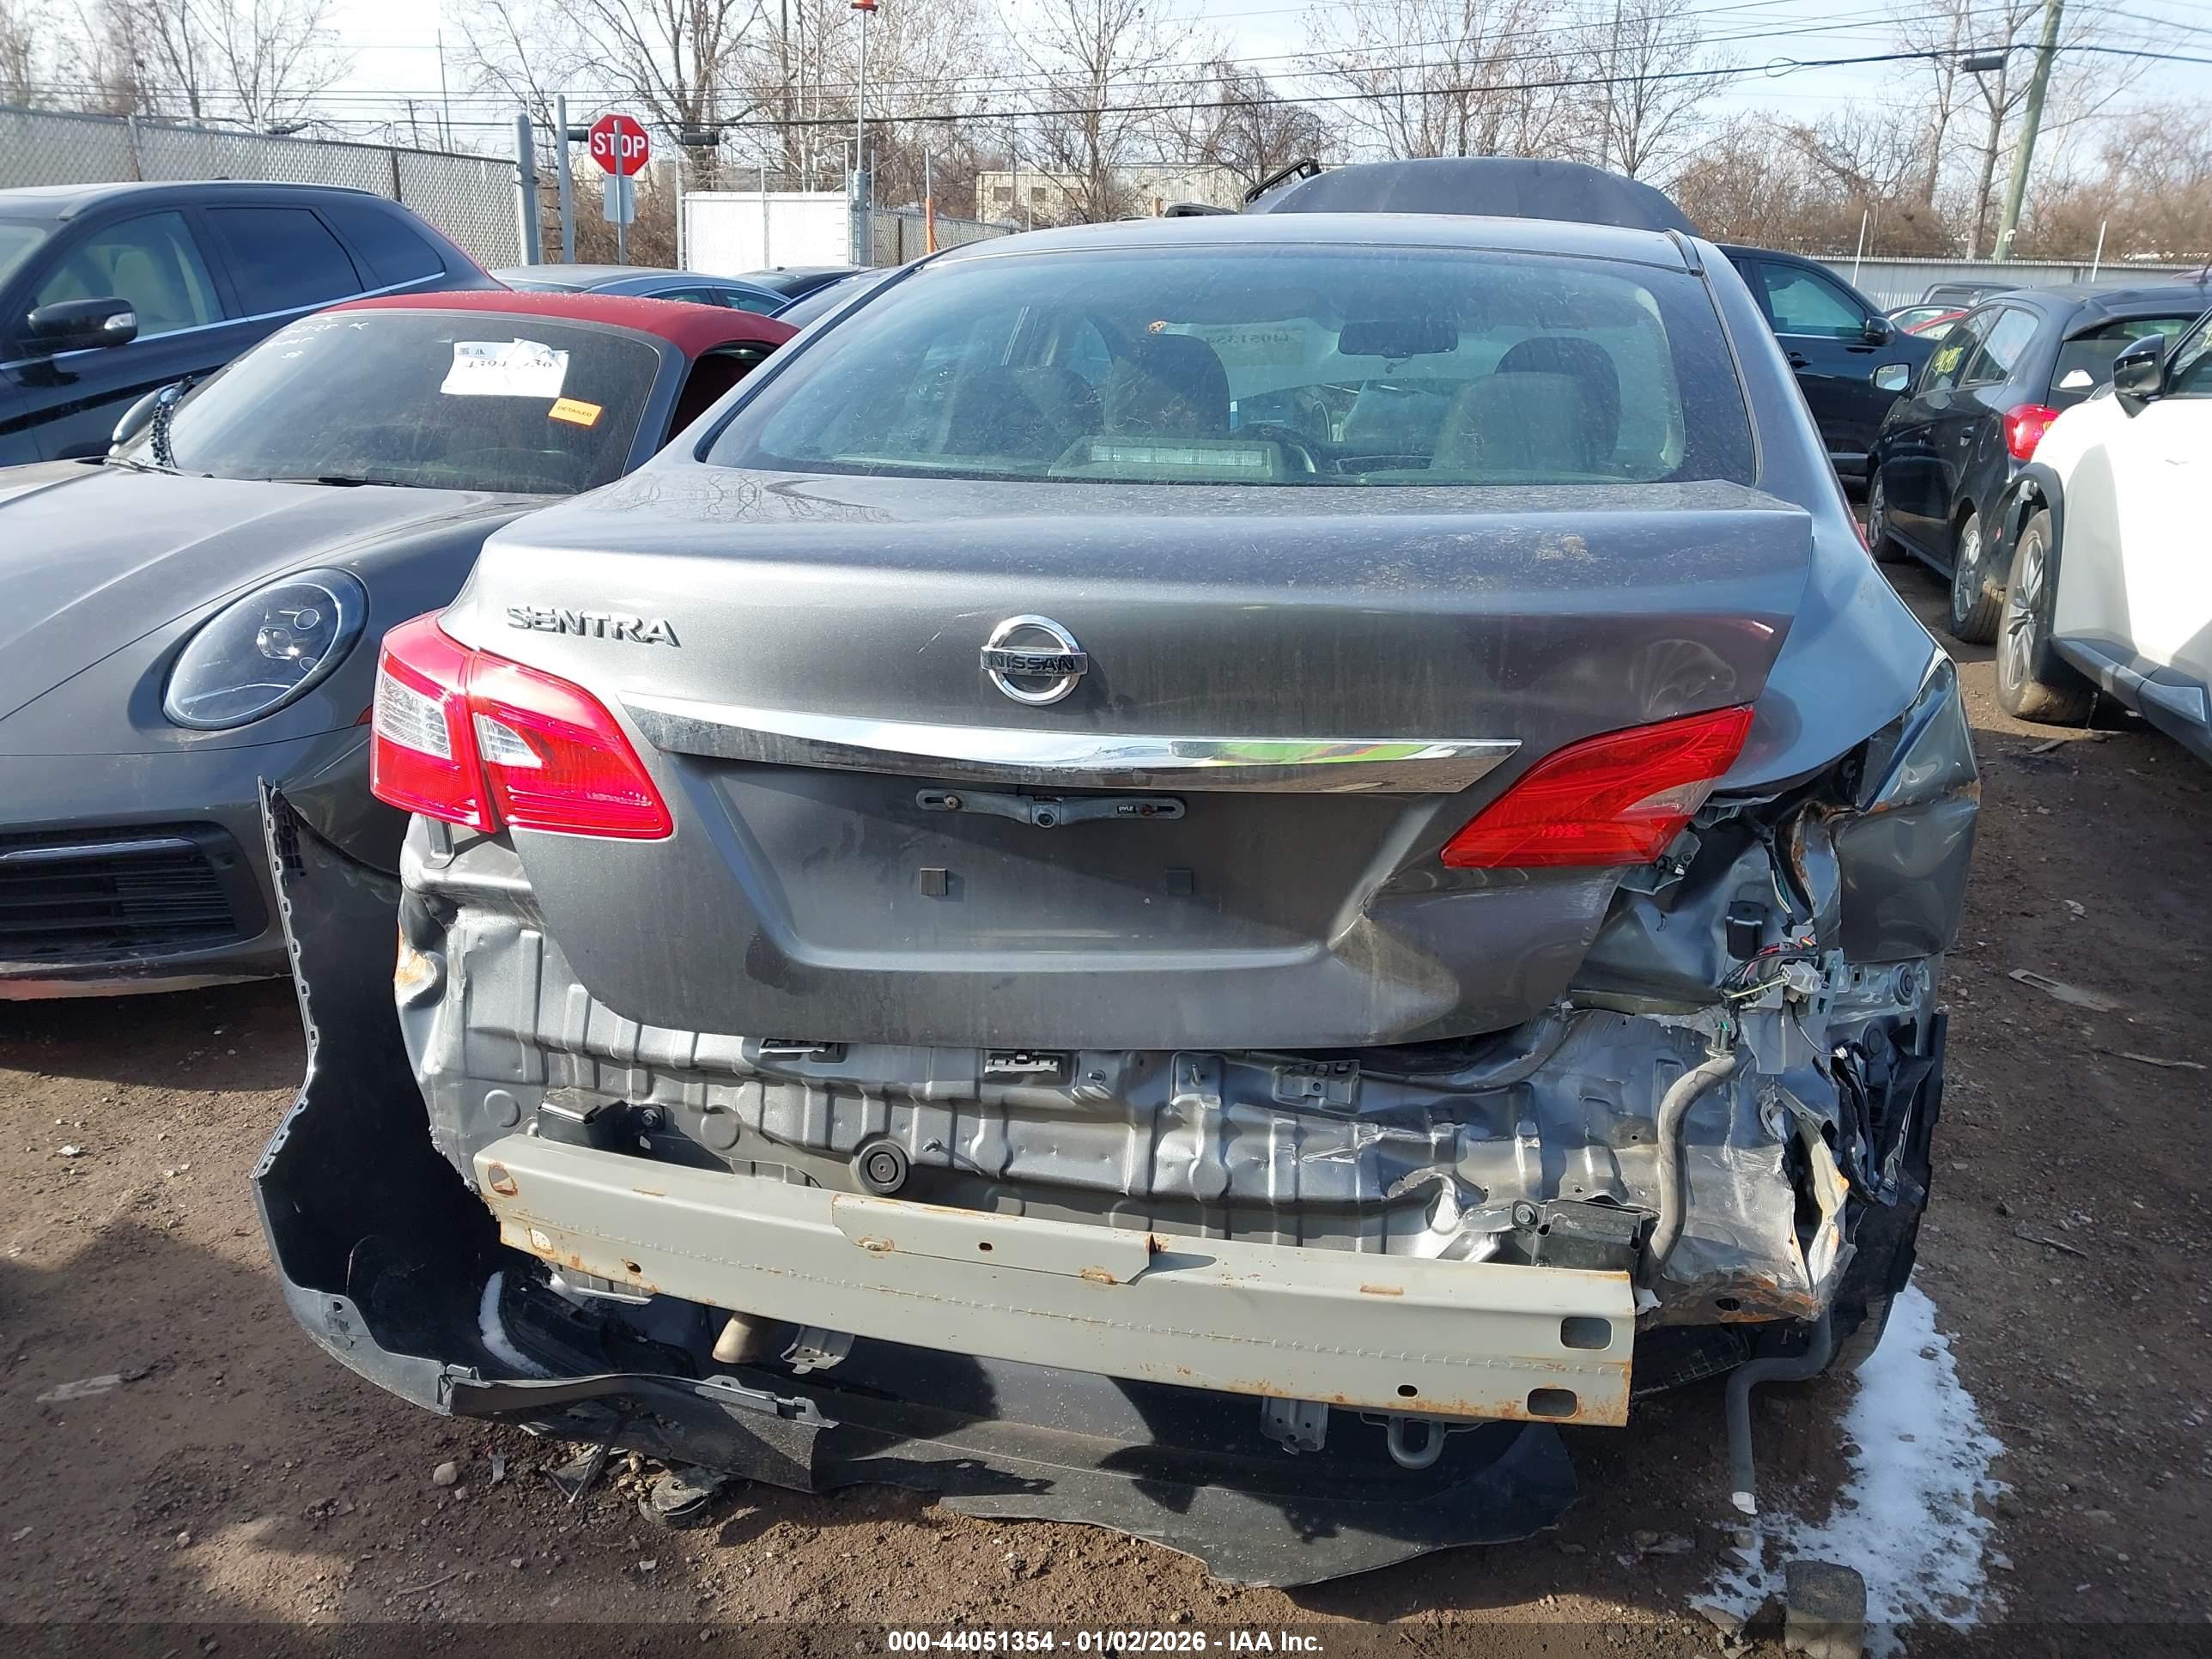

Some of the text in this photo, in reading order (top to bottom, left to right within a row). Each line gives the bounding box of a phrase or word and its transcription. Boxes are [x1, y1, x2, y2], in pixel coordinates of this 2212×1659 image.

[593, 131, 646, 158] STOP
[557, 405, 592, 417] DETAILED
[507, 605, 681, 647] SENTRA
[991, 653, 1075, 672] NISSAN
